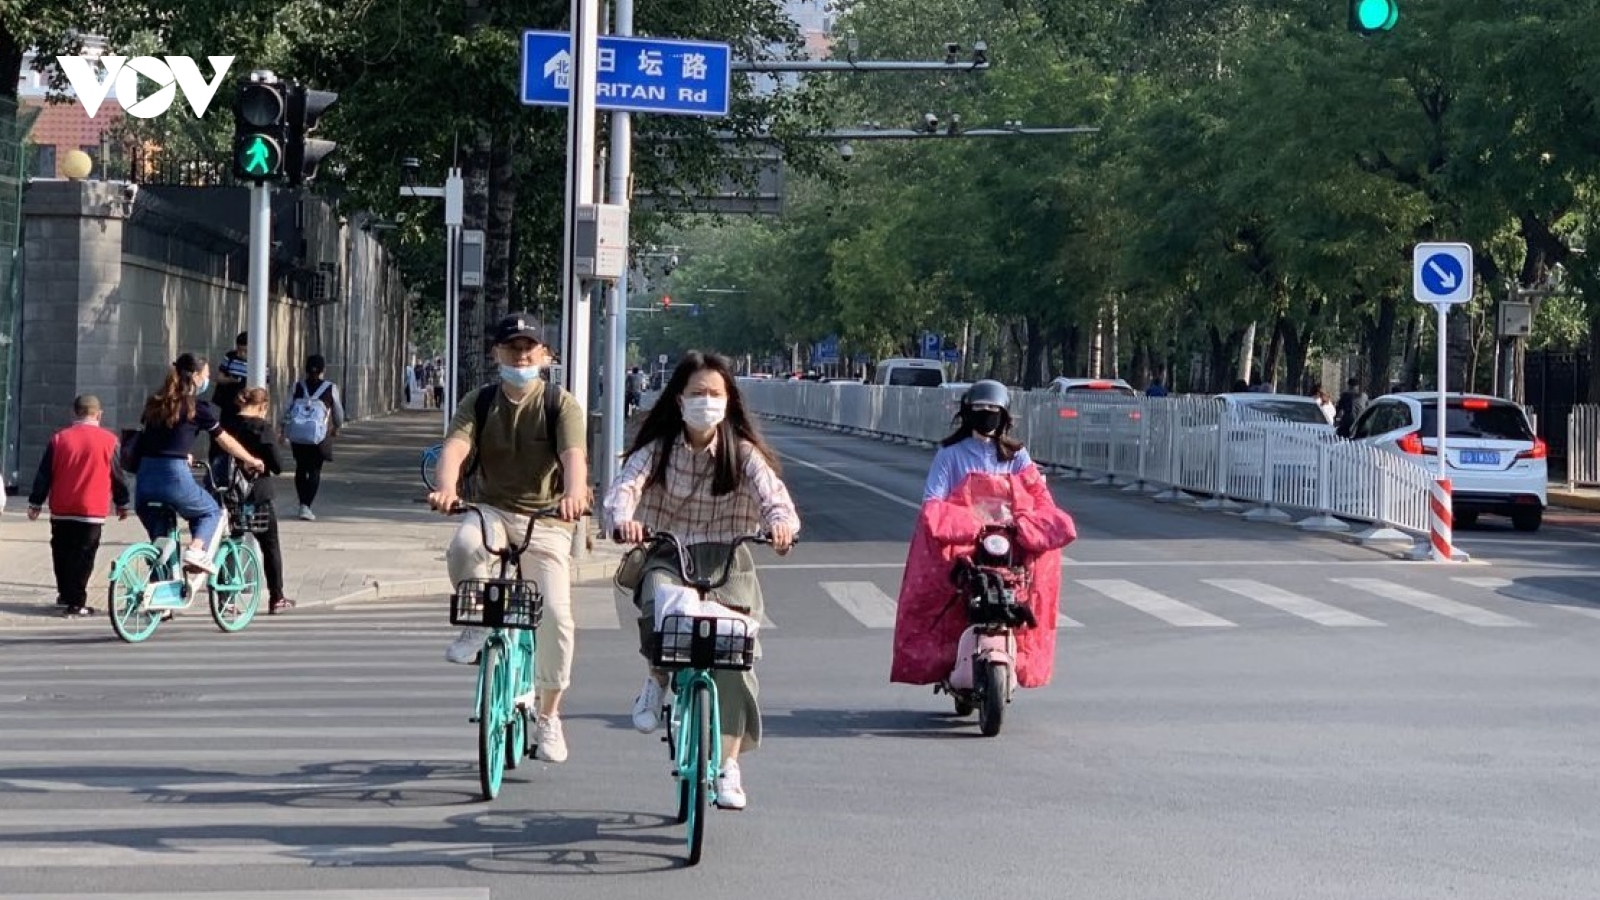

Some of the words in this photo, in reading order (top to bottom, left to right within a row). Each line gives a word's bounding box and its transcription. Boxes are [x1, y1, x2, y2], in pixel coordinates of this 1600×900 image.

[556, 59, 569, 74] 北
[597, 47, 708, 80] 日坛路
[557, 75, 568, 86] N
[597, 82, 666, 100] RITAN
[678, 88, 708, 103] Rd
[925, 333, 938, 351] P
